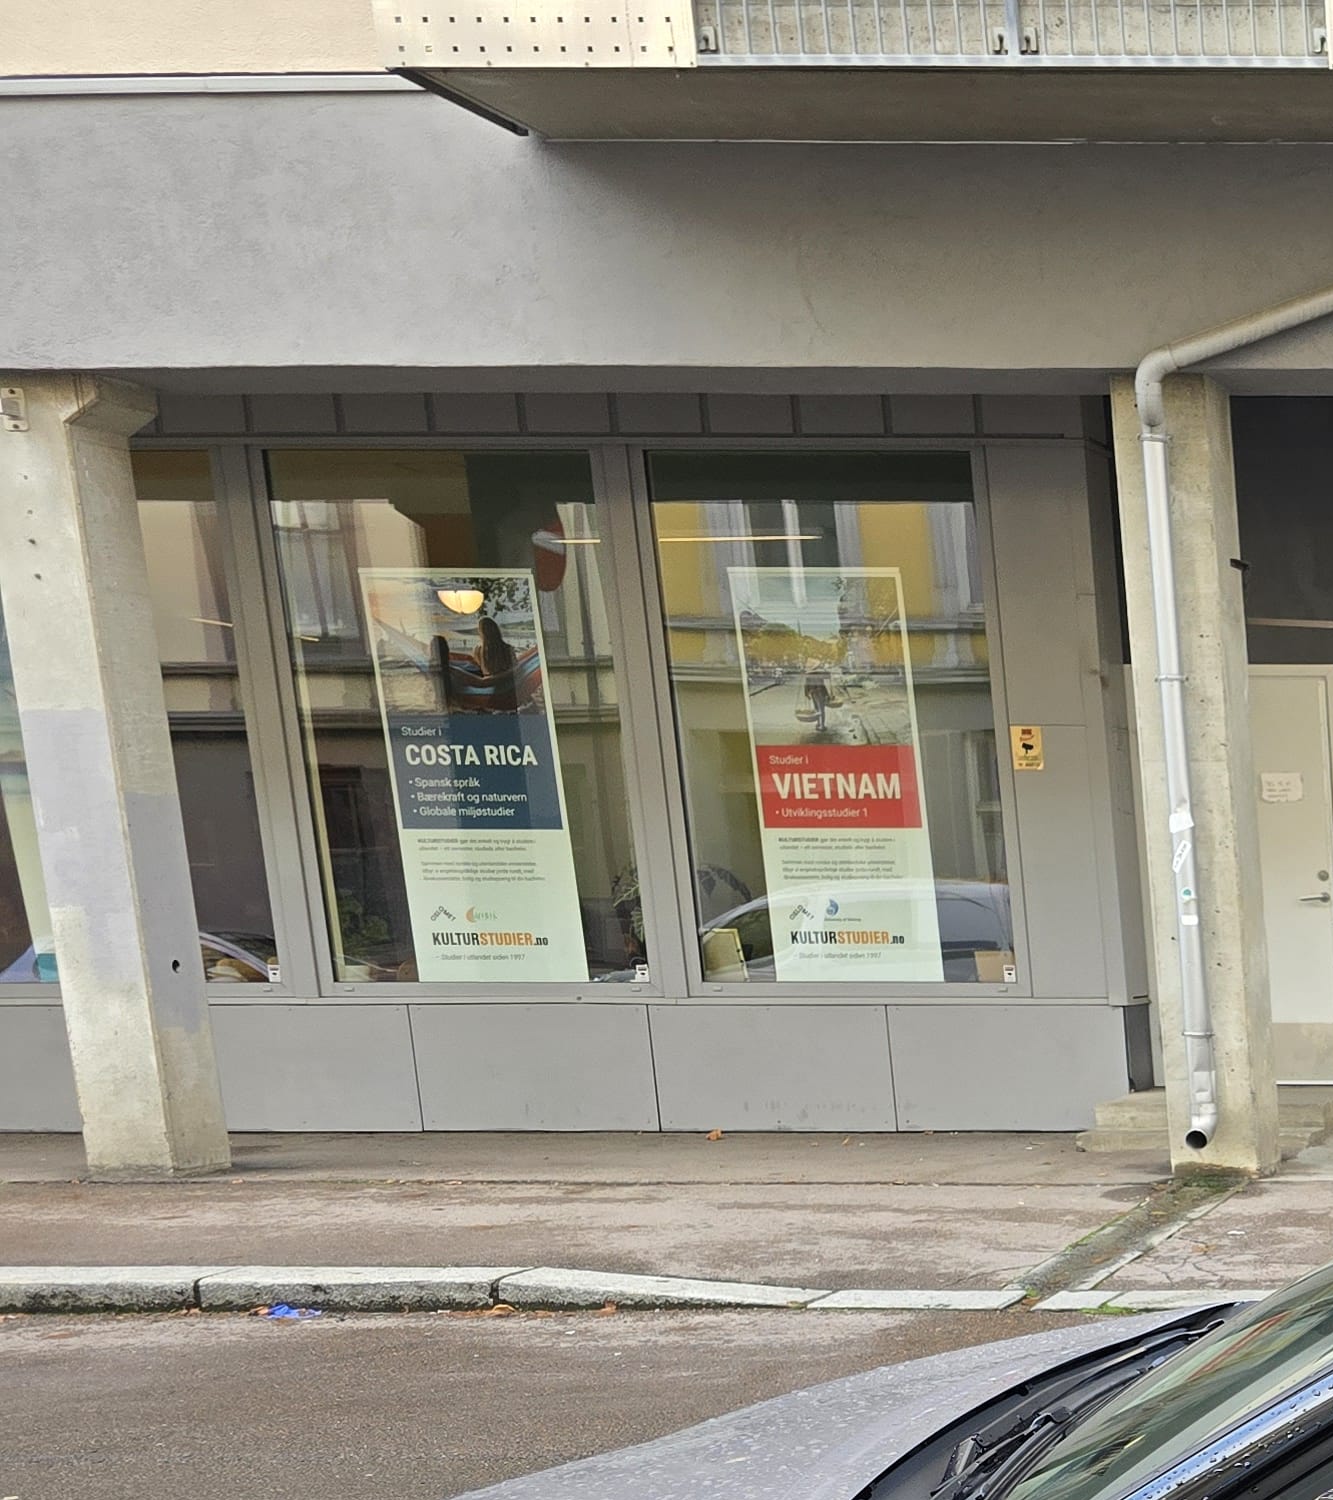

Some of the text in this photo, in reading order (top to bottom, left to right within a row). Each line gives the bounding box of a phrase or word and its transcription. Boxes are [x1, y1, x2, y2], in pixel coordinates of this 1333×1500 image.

[401, 726, 442, 736] Studier i
[405, 744, 538, 766] COSTA RICA
[769, 755, 809, 765] Studier i
[414, 777, 481, 789] Spansk språk
[771, 772, 901, 800] VIETNAM
[416, 792, 527, 804] Bærekraft og naturvern
[419, 807, 515, 818] Globale miljøstudier
[781, 808, 868, 820] Utviklingsstudier 1
[432, 932, 549, 947] KULTURSTUDIER.no
[791, 930, 905, 945] KULTURSTUDIER.no
